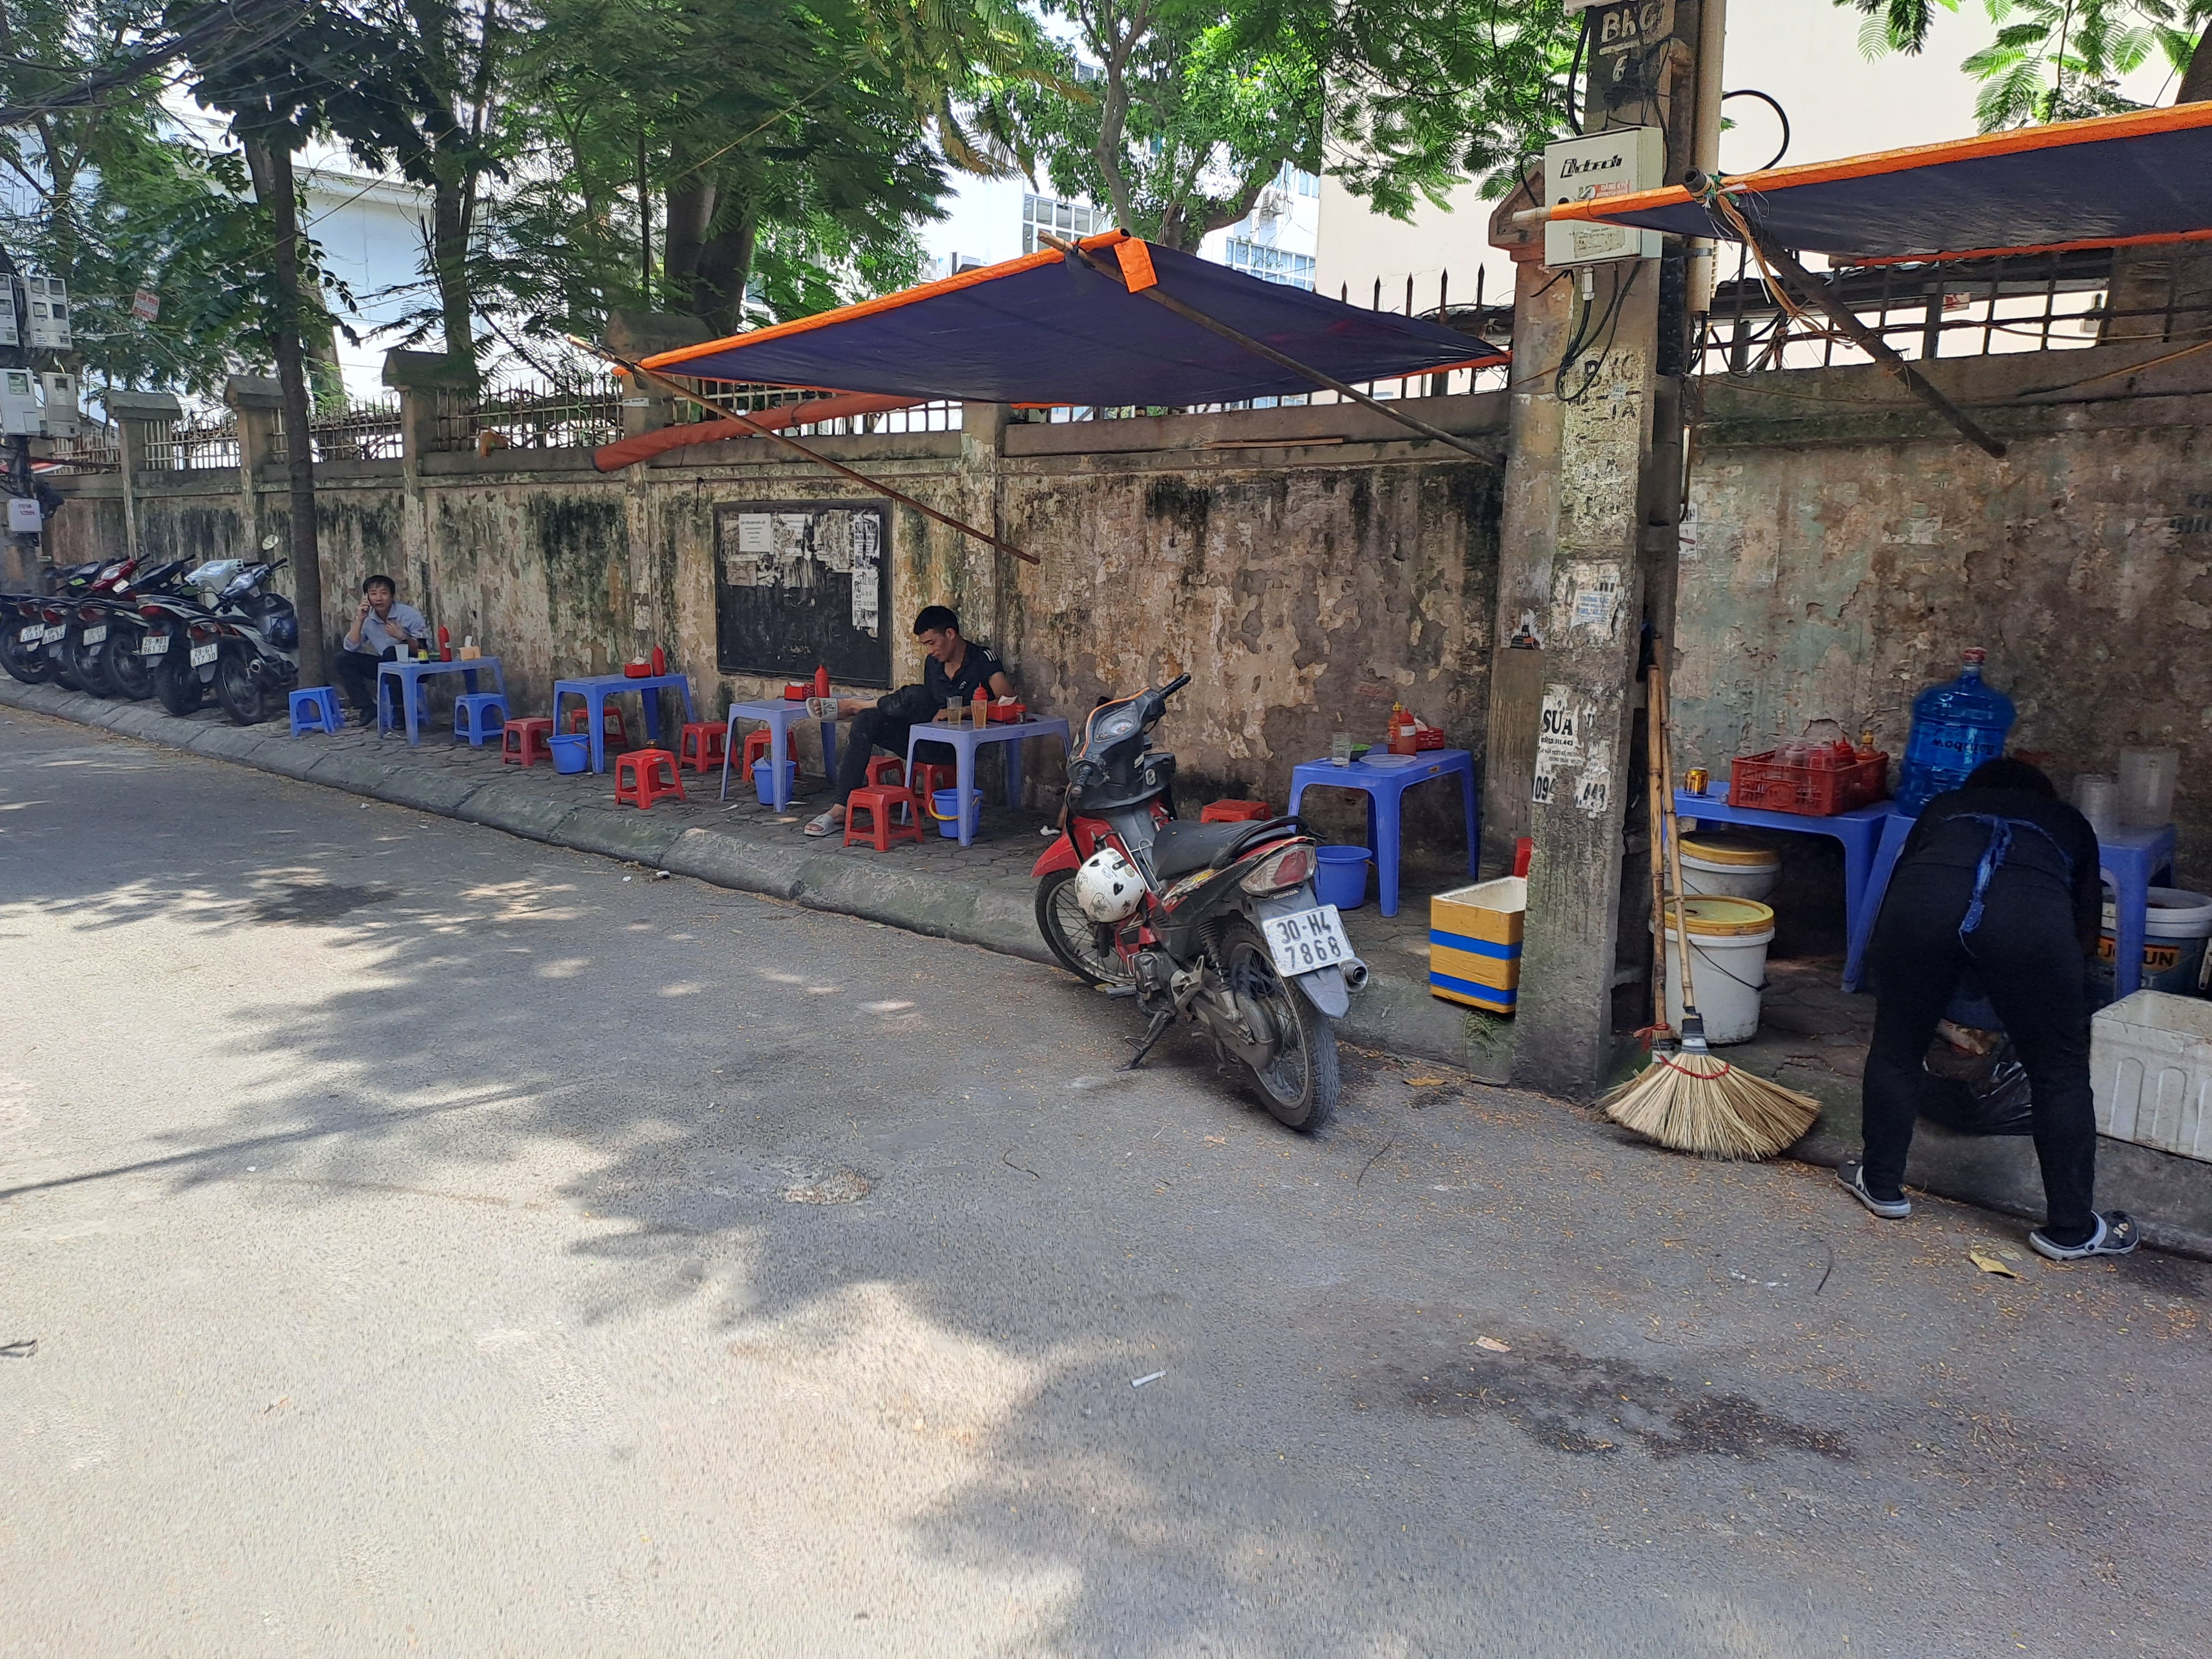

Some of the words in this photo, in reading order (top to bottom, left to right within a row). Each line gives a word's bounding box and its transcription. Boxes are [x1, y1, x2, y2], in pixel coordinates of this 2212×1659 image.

[143, 644, 166, 654] 961.70
[194, 645, 213, 658] 29-G1
[1543, 700, 1573, 736] SỬA
[1273, 889, 1299, 900] HONDA
[1285, 936, 1342, 969] 7868
[2103, 943, 2174, 966] JUN
